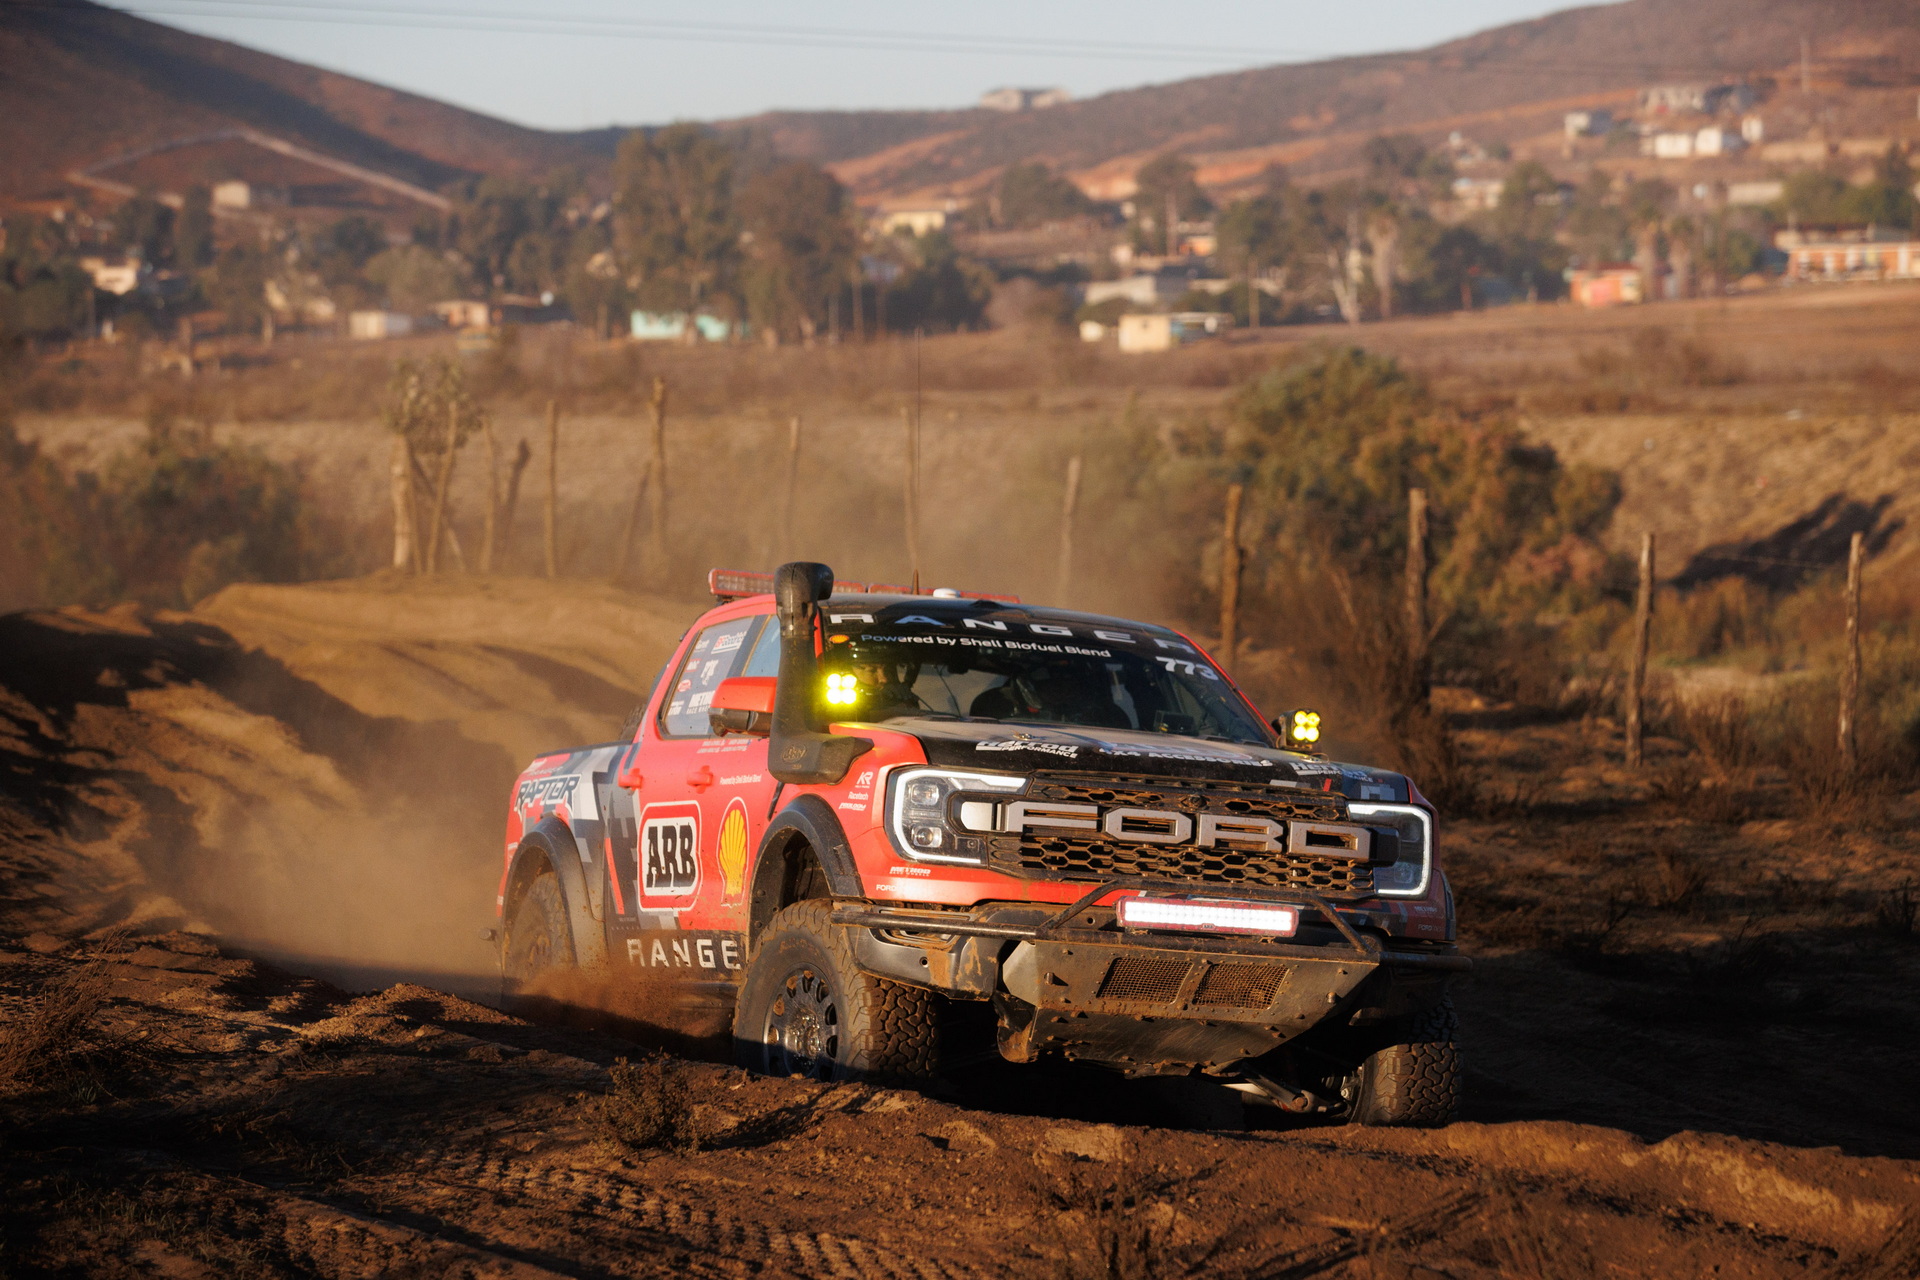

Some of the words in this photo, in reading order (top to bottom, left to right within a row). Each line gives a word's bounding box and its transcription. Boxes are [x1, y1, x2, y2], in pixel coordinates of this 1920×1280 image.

[829, 613, 1196, 655] RANGER
[861, 633, 934, 645] Powered
[936, 635, 957, 647] by
[960, 637, 1002, 649] Shell
[1005, 640, 1063, 654] Biofuel
[1064, 645, 1112, 659] Blend
[1155, 656, 1220, 681] 773
[1001, 745, 1079, 759] PERFORMANCE
[514, 773, 582, 820] RAPTOR
[1004, 800, 1372, 863] FORD
[645, 824, 697, 888] ARB
[626, 937, 742, 970] RANGE
